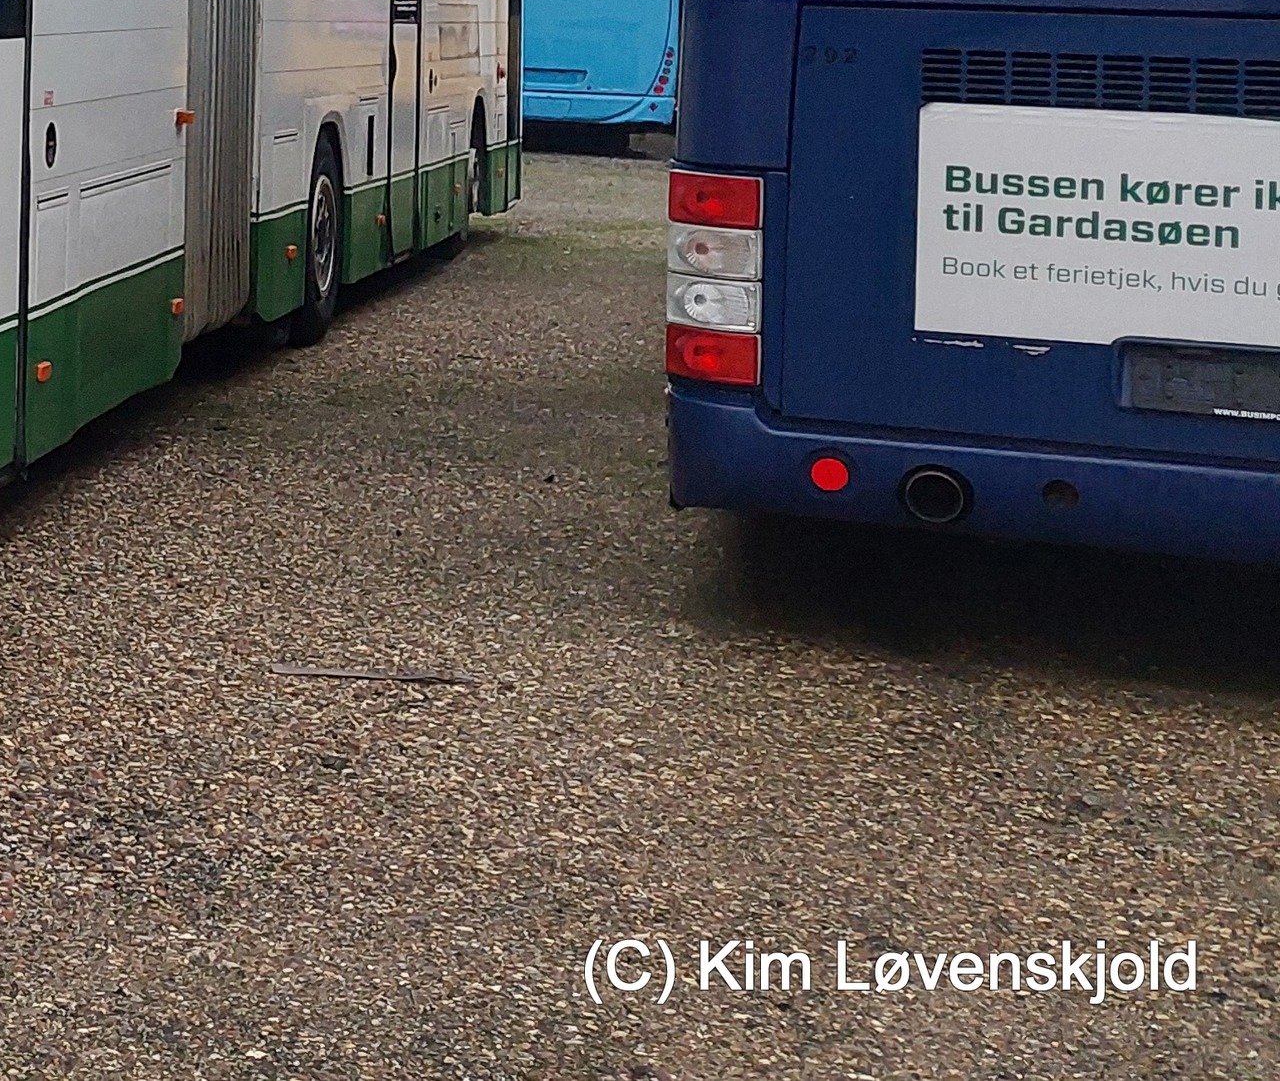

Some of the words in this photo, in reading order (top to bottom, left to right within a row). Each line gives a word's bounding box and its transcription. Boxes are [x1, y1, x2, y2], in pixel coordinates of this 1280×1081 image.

[944, 165, 1105, 201] Bussen
[1120, 173, 1241, 209] kører
[943, 202, 983, 233] til
[997, 206, 1240, 249] Gardasøen
[942, 256, 1006, 280] Book
[1013, 263, 1039, 281] et
[1046, 263, 1162, 293] ferietjek,
[1171, 271, 1225, 294] hvis
[1233, 276, 1268, 297] du
